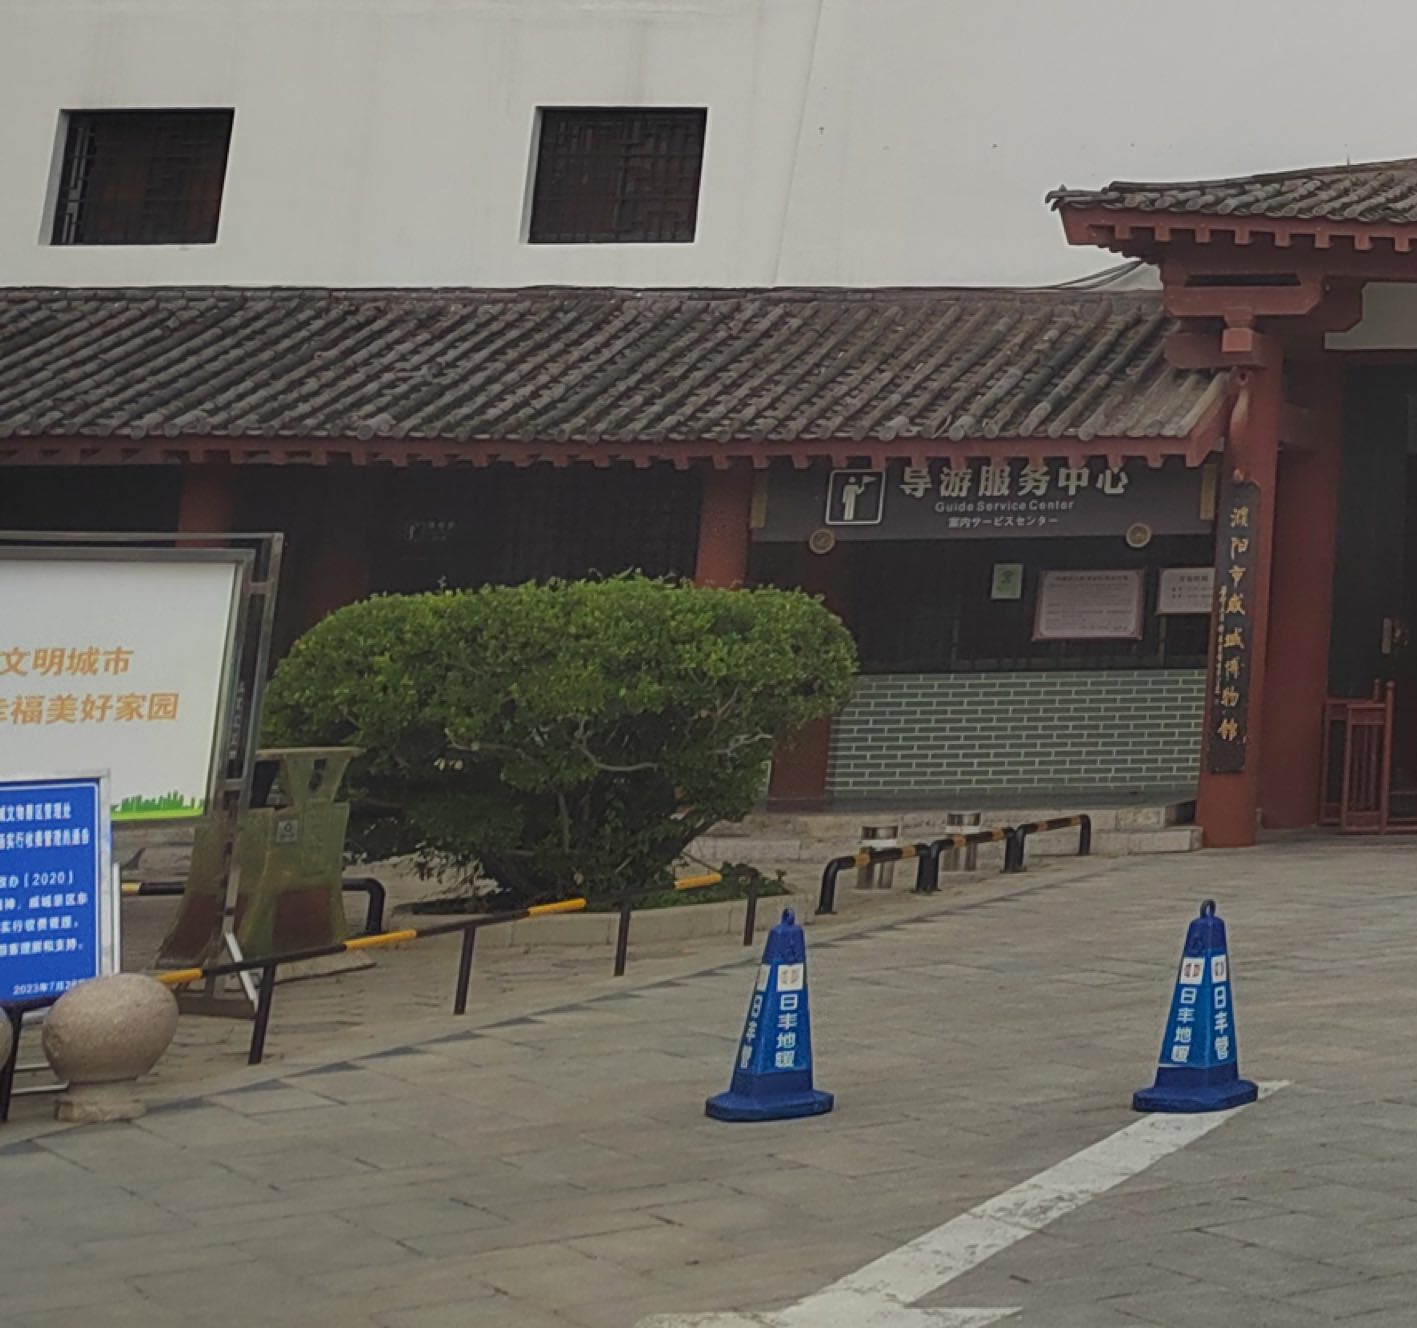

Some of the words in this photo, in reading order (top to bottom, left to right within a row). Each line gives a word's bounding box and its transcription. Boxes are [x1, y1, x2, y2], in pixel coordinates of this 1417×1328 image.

[900, 465, 1129, 497] 导游服务中心
[934, 500, 974, 513] Guide
[976, 500, 1027, 512] Service
[1029, 498, 1074, 511] Center
[0, 646, 135, 676] 文明城市
